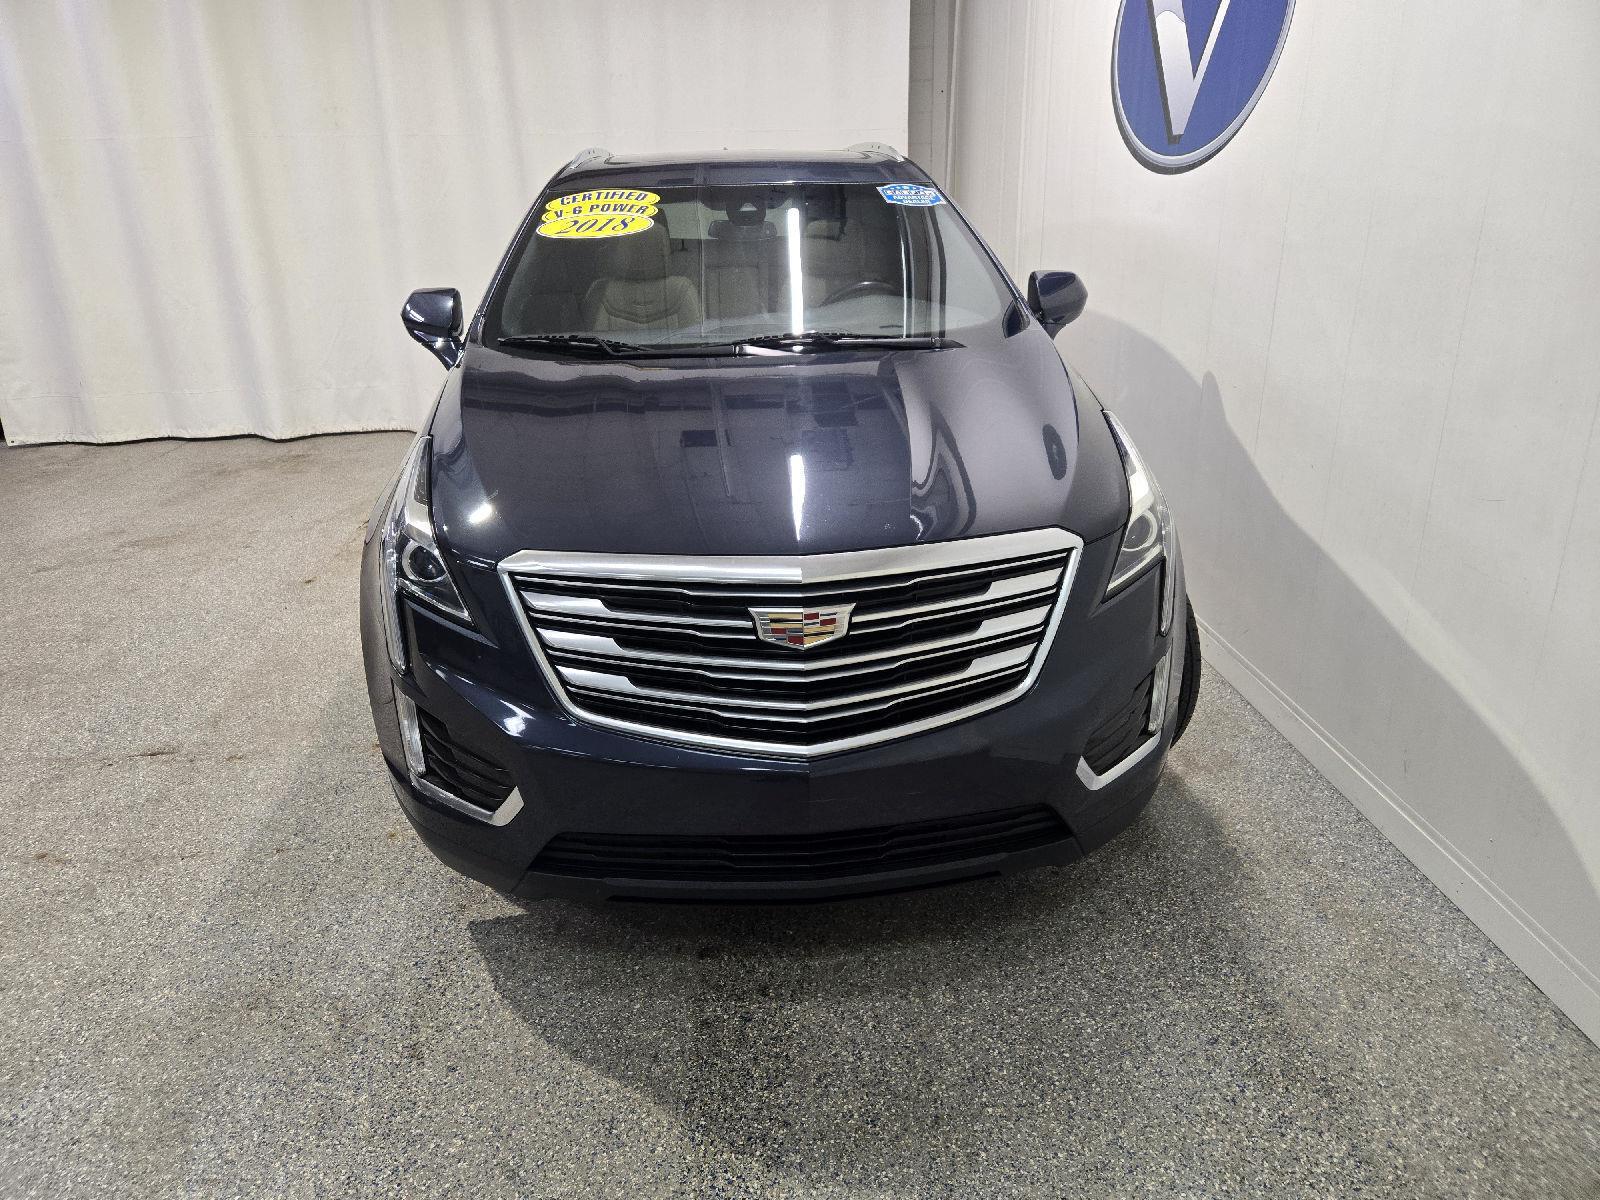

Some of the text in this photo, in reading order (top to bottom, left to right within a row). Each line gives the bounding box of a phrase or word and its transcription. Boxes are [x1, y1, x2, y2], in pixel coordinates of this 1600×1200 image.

[1150, 0, 1231, 135] V
[560, 191, 648, 206] CERTIFIED
[589, 203, 649, 215] POWER
[555, 217, 635, 235] 2018
